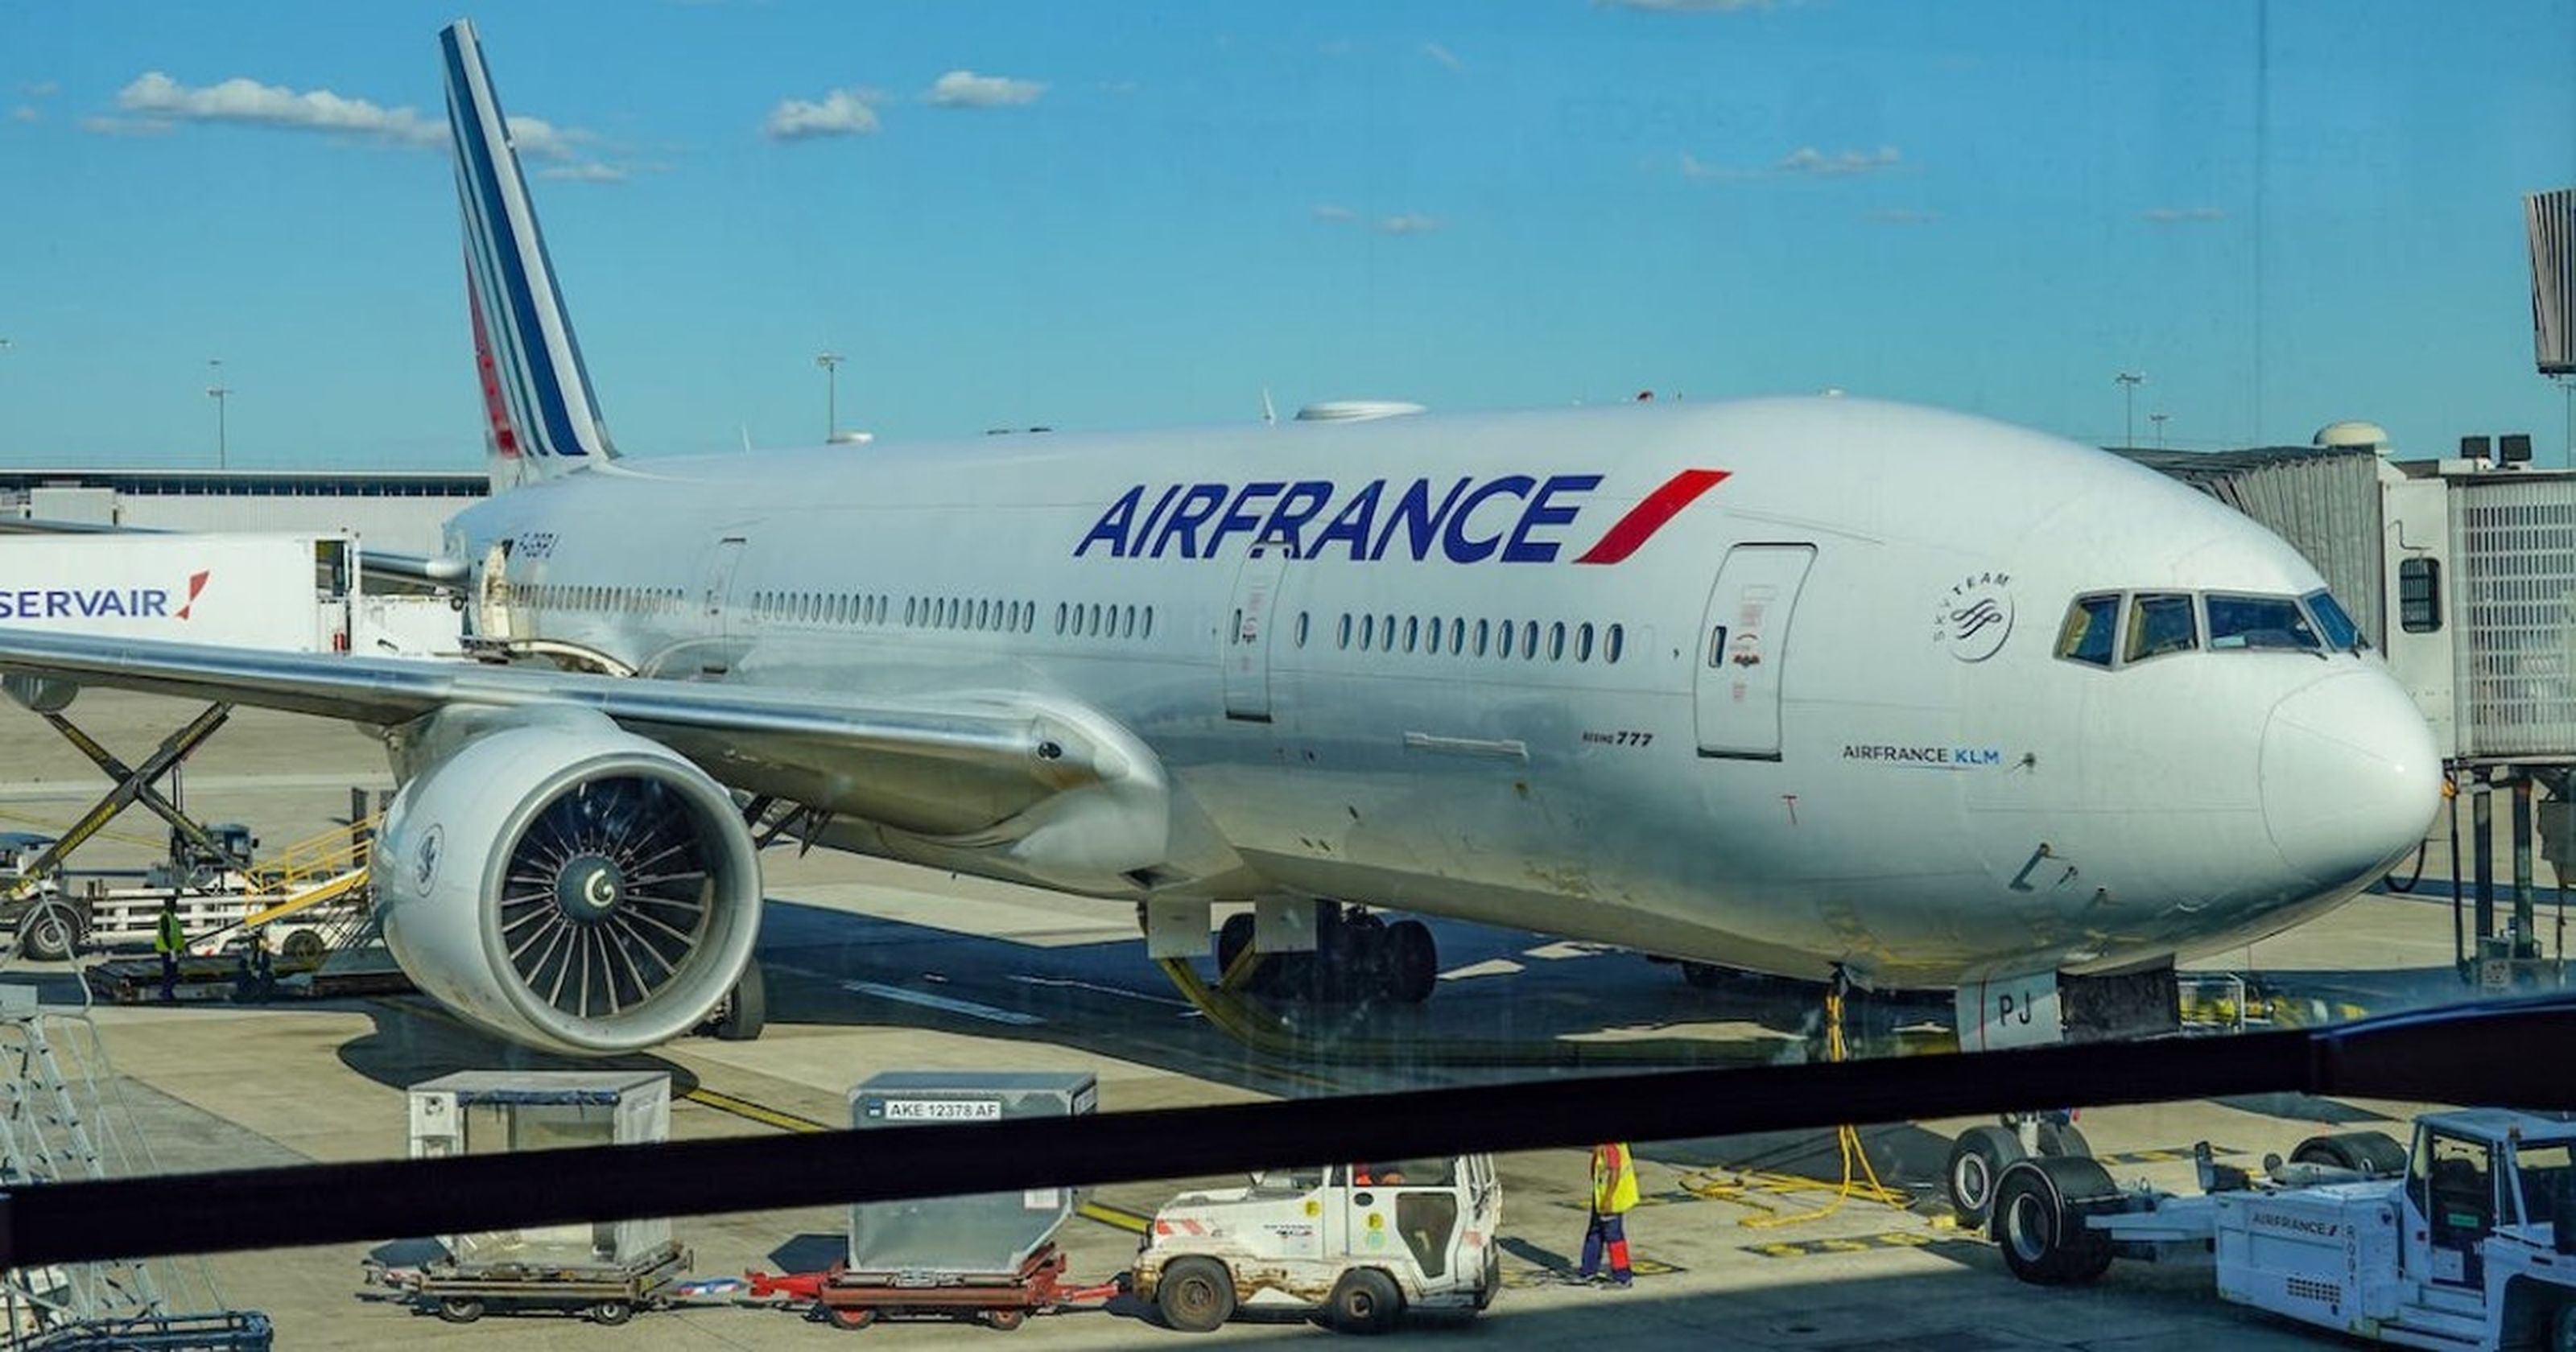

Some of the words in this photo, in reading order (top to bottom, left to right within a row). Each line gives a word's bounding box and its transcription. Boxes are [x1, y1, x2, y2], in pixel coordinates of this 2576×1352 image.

[1074, 474, 1606, 564] AIRFRANCE
[0, 590, 167, 618] SERVAIR
[1616, 731, 1653, 747] 777
[1843, 745, 1948, 763] AIRFRANCE
[1955, 748, 2000, 765] KLM
[1998, 990, 2032, 1027] PJ
[890, 1103, 924, 1117] AKE
[929, 1104, 972, 1117] 12378
[975, 1105, 997, 1117] AF
[2252, 1212, 2325, 1235] AIRFRANCE
